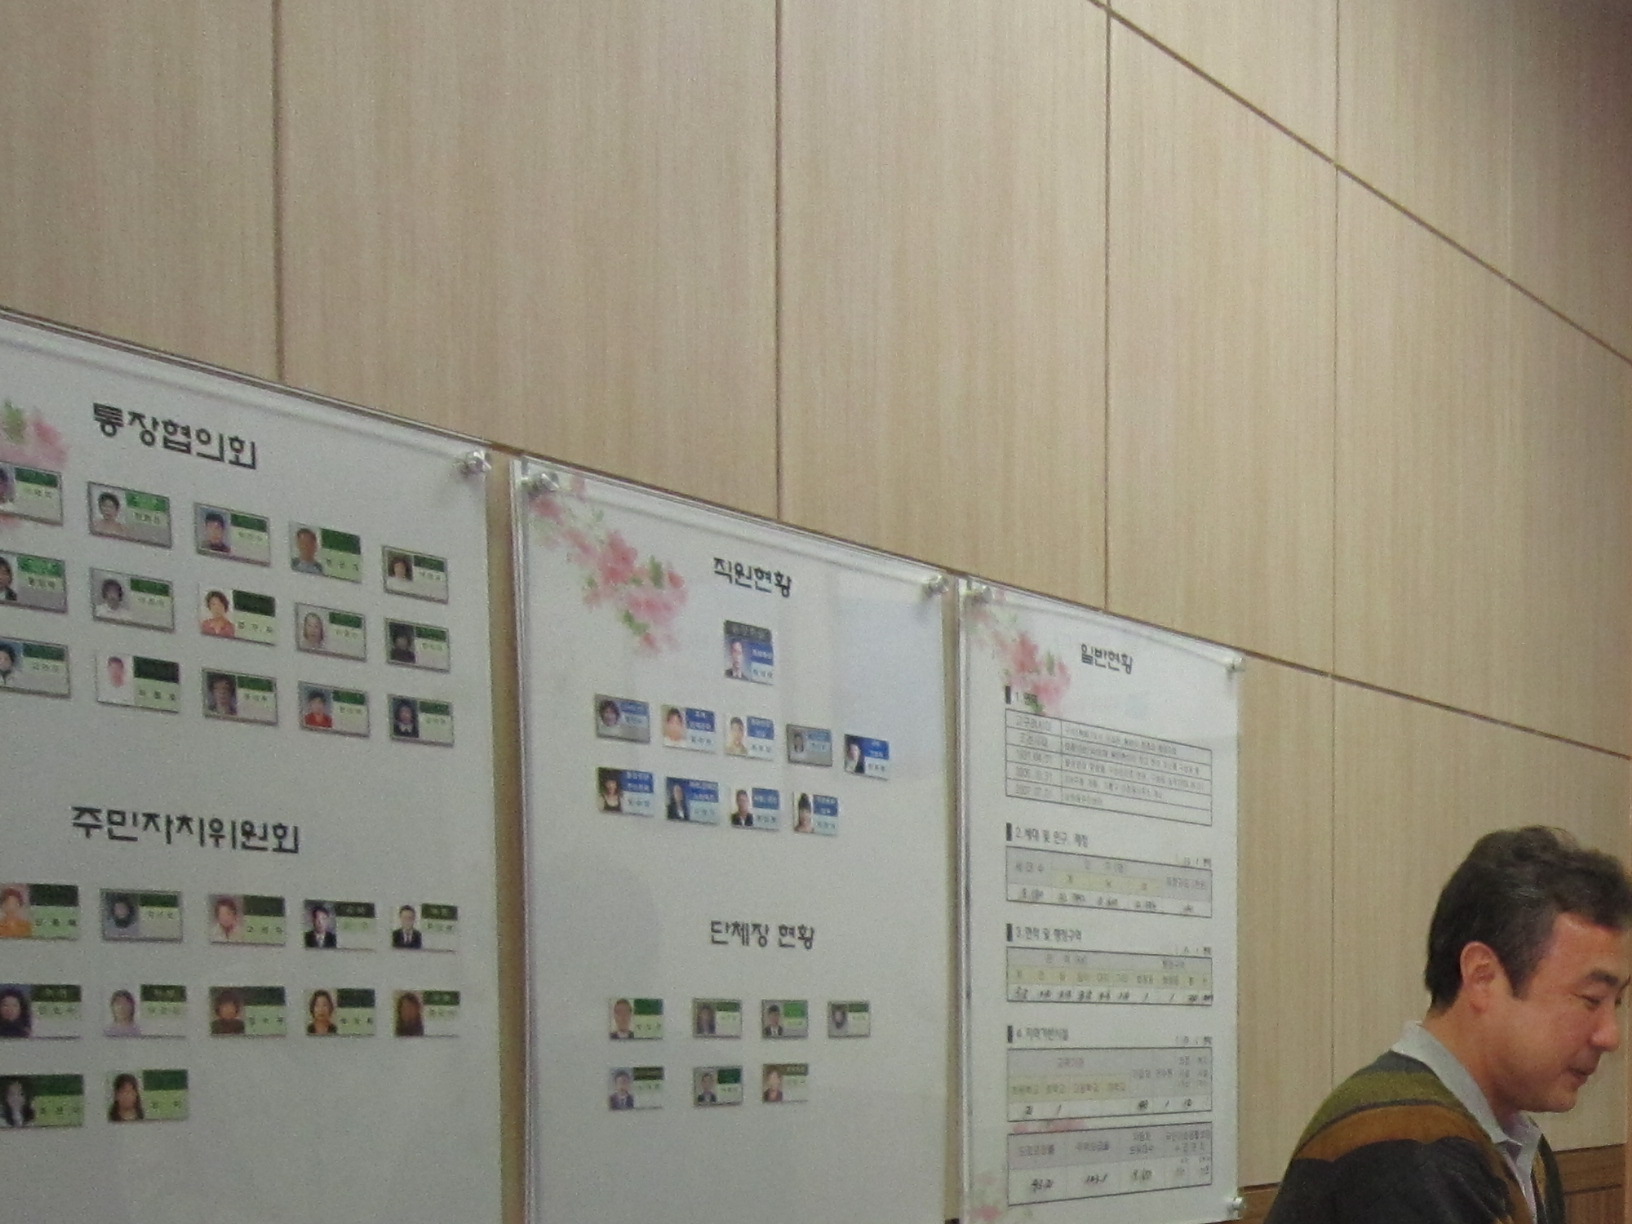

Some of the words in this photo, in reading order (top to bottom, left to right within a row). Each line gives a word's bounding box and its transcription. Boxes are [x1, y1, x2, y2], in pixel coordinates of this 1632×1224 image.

[92, 402, 257, 470] 통장협의회
[713, 556, 793, 598] 직원현황
[1080, 643, 1134, 675] 일반현황
[71, 804, 300, 855] 주민자치위원회
[709, 919, 770, 949] 단체장
[777, 922, 816, 951] 현황
